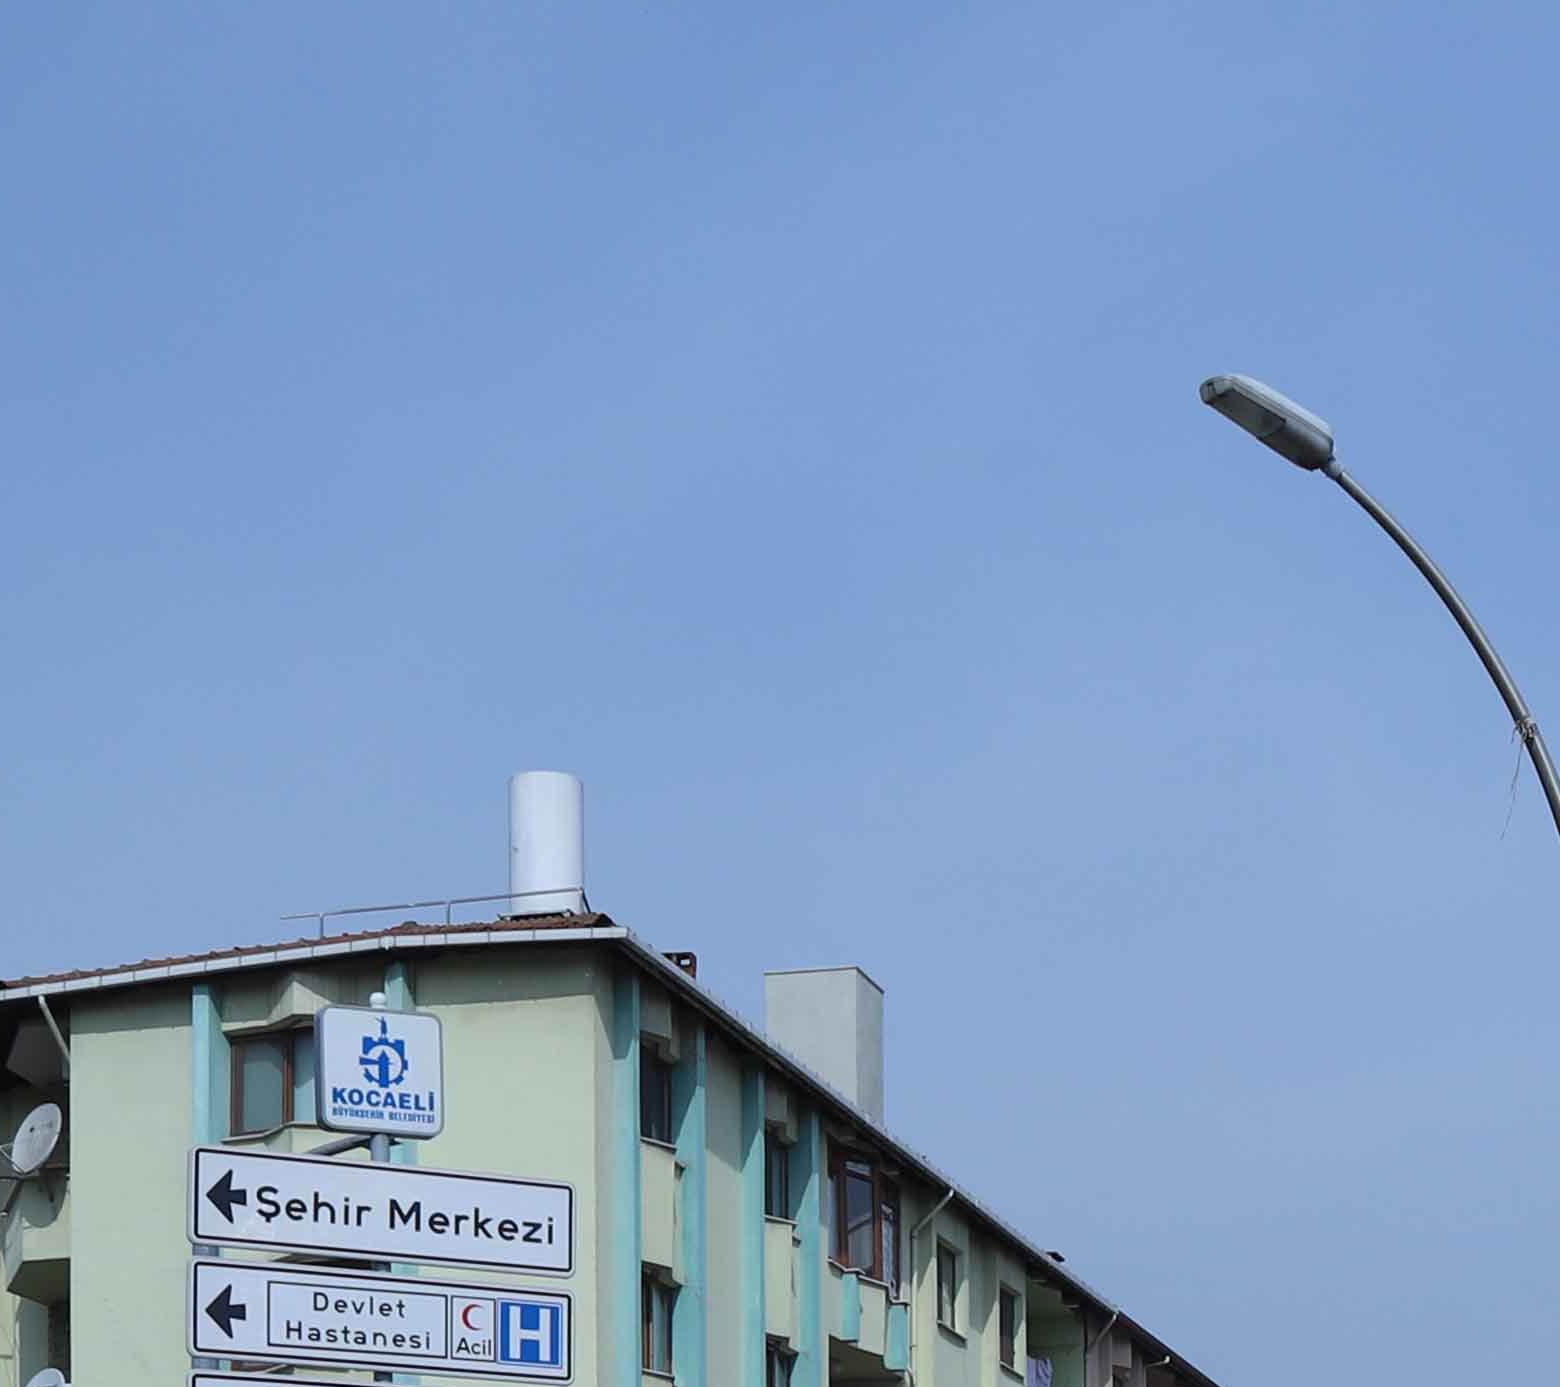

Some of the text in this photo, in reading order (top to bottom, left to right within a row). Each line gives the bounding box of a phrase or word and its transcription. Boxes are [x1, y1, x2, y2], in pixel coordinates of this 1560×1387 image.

[332, 1086, 435, 1111] KOCAELİ
[256, 1185, 555, 1245] Şehir Merkezi
[313, 1292, 407, 1319] Devlet
[285, 1320, 432, 1351] Hastanesi
[456, 1338, 492, 1358] Acil
[509, 1306, 554, 1362] H
